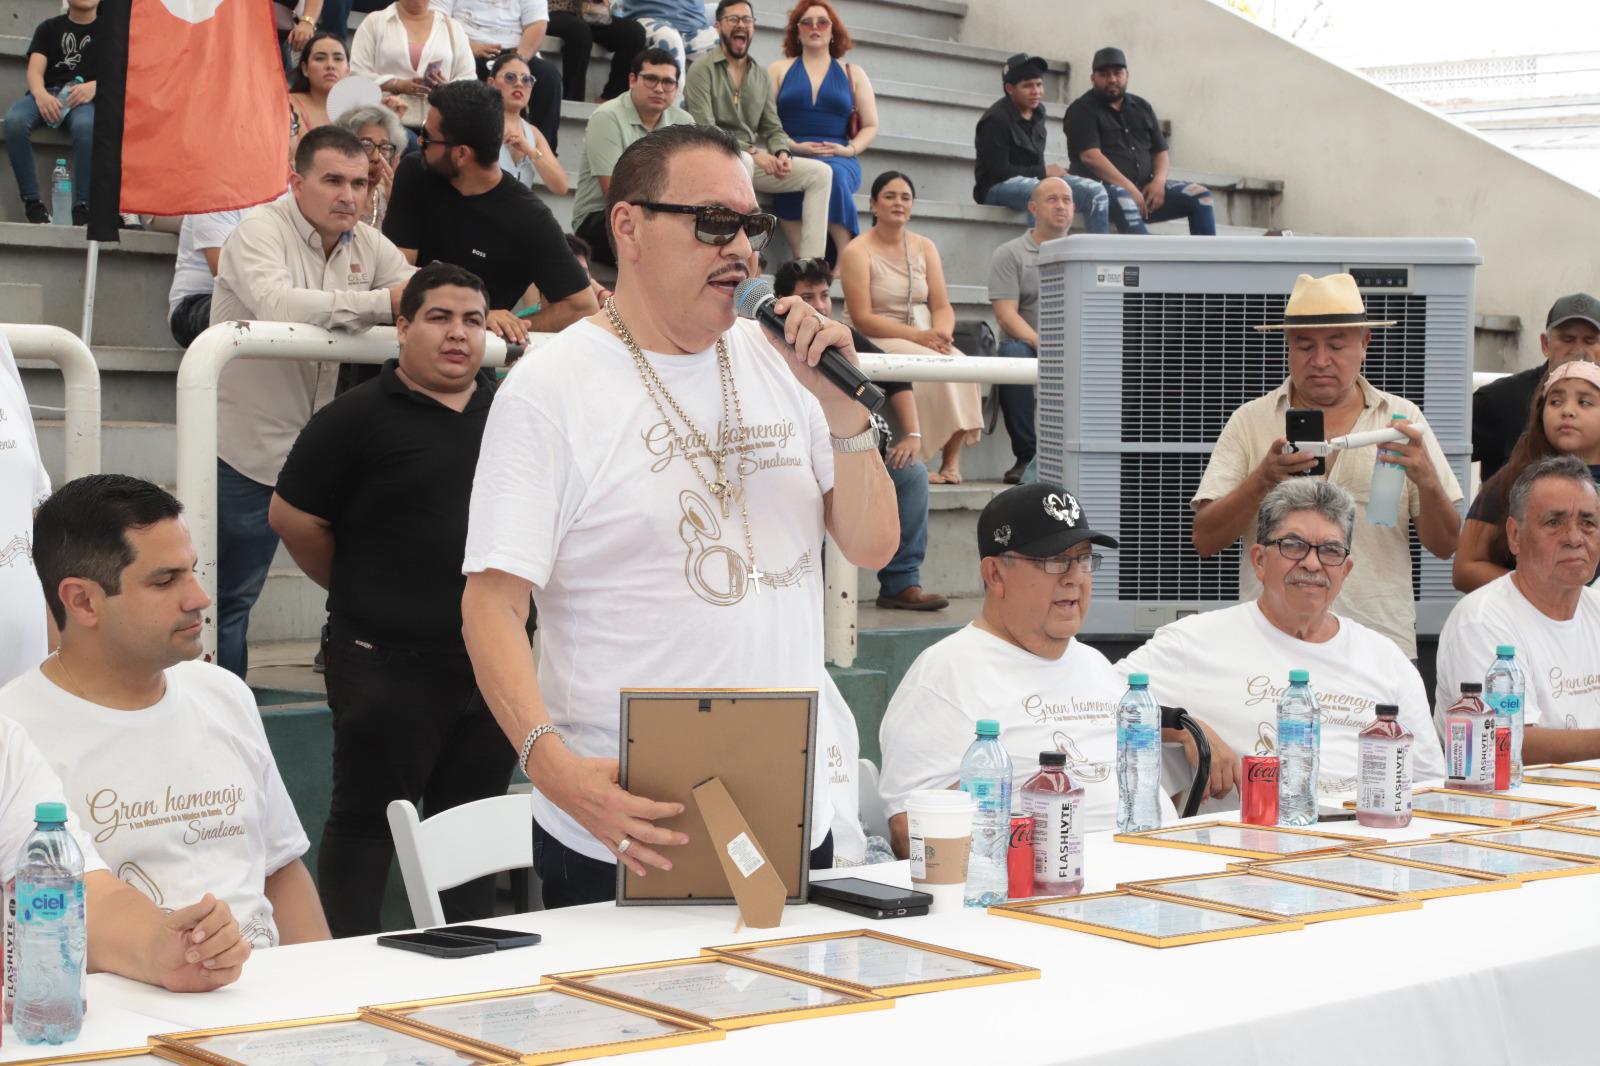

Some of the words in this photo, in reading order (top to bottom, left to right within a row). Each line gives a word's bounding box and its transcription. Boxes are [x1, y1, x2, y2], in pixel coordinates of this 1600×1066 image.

[472, 248, 487, 258] BOSS
[641, 422, 710, 473] Gran
[716, 419, 796, 448] homenaje
[1021, 694, 1070, 724] Gran
[1245, 675, 1286, 706] Gra
[1312, 686, 1376, 714] omenaje
[1500, 698, 1519, 709] ciel
[1394, 747, 1403, 812] FLASHLYTE
[86, 788, 158, 843] Gran
[165, 784, 245, 816] homenaje
[1059, 802, 1070, 878] FLASHLYTE
[32, 893, 65, 910] ciel
[6, 920, 14, 998] FLASHLYTE
